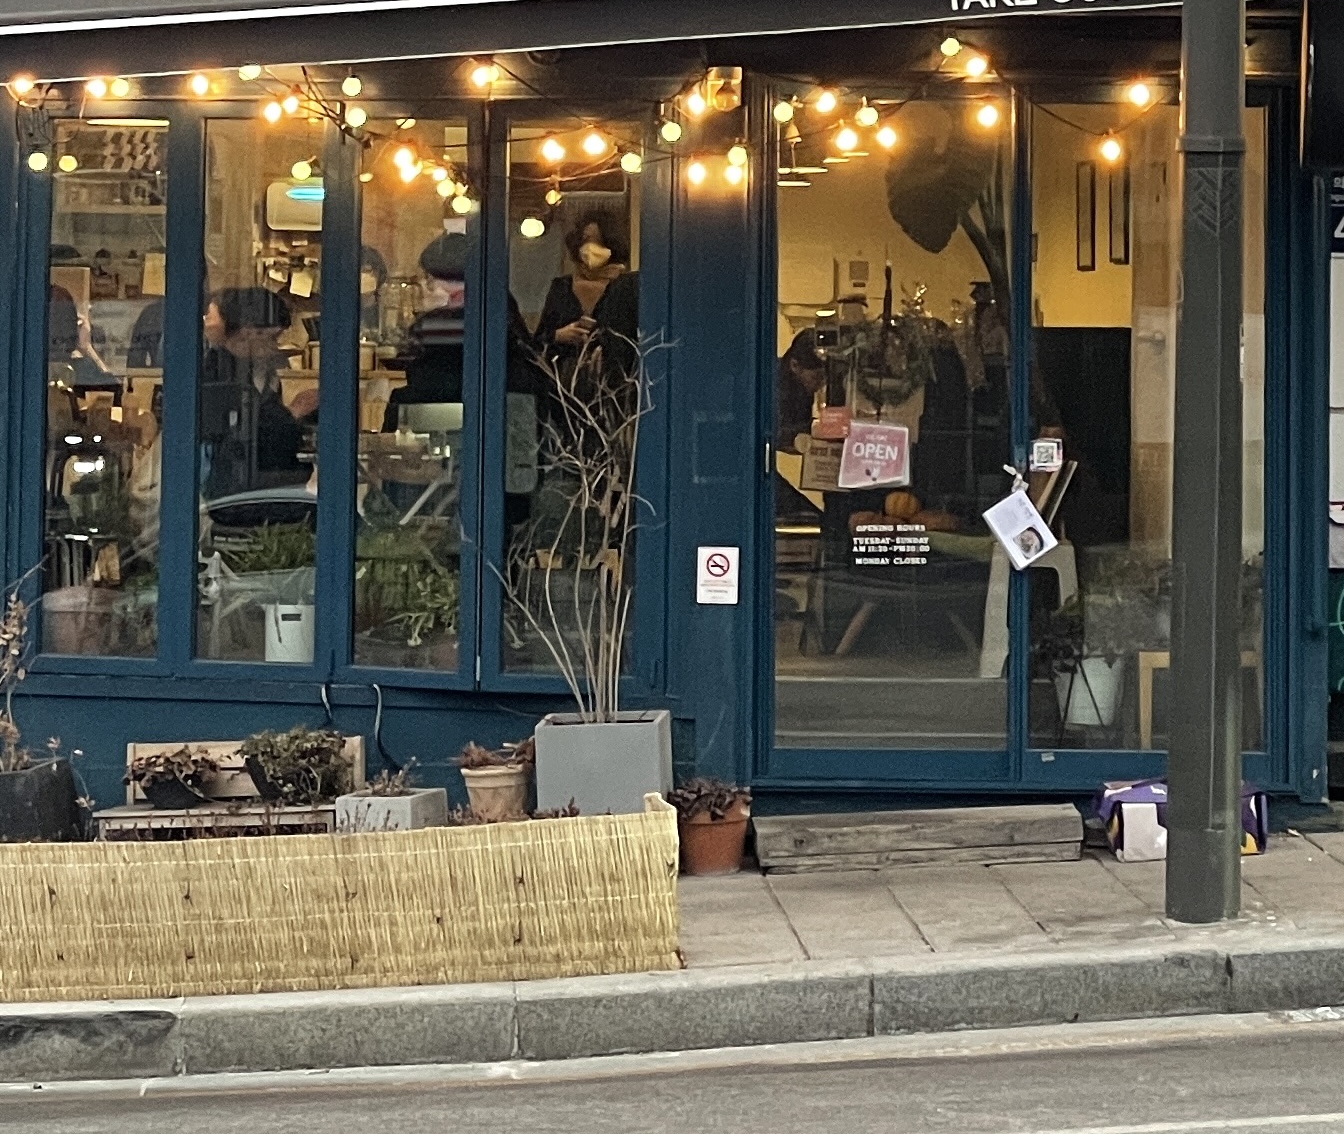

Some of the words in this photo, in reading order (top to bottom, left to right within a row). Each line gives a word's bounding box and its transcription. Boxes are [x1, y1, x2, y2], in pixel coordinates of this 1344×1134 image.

[852, 442, 898, 461] OPEN
[856, 524, 894, 532] OPENING
[896, 524, 926, 532] HOURS
[855, 557, 890, 565] MONDAY
[893, 557, 927, 565] CLOSED
